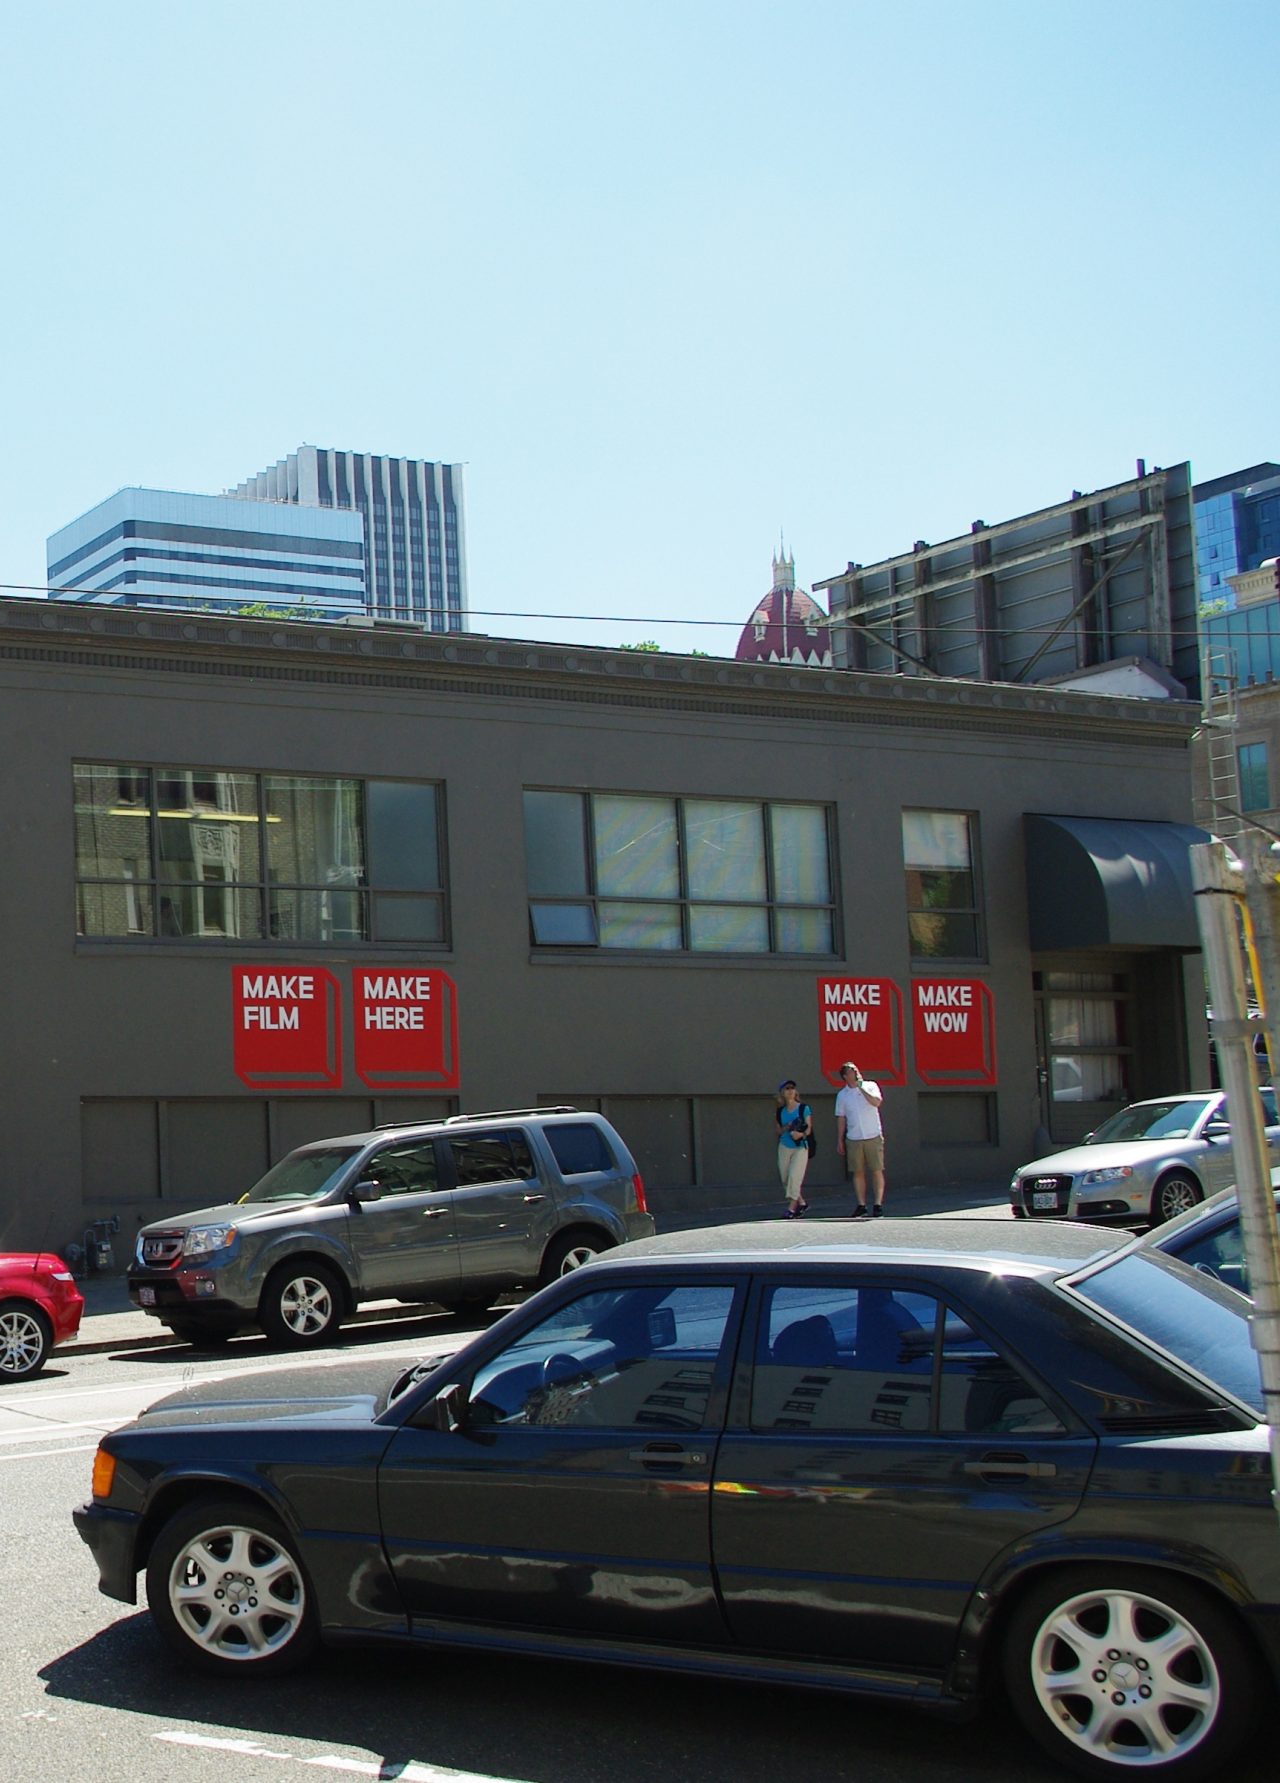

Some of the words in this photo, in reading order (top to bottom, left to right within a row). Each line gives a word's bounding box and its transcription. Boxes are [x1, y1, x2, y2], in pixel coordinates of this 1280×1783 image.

[242, 975, 314, 999] MAKE
[363, 976, 430, 1000] MAKE
[824, 984, 881, 1006] MAKE
[918, 985, 973, 1007] MAKE
[243, 1006, 299, 1030] FILM
[364, 1006, 424, 1030] HERE
[825, 1011, 868, 1032] NOW
[924, 1012, 968, 1033] WOW
